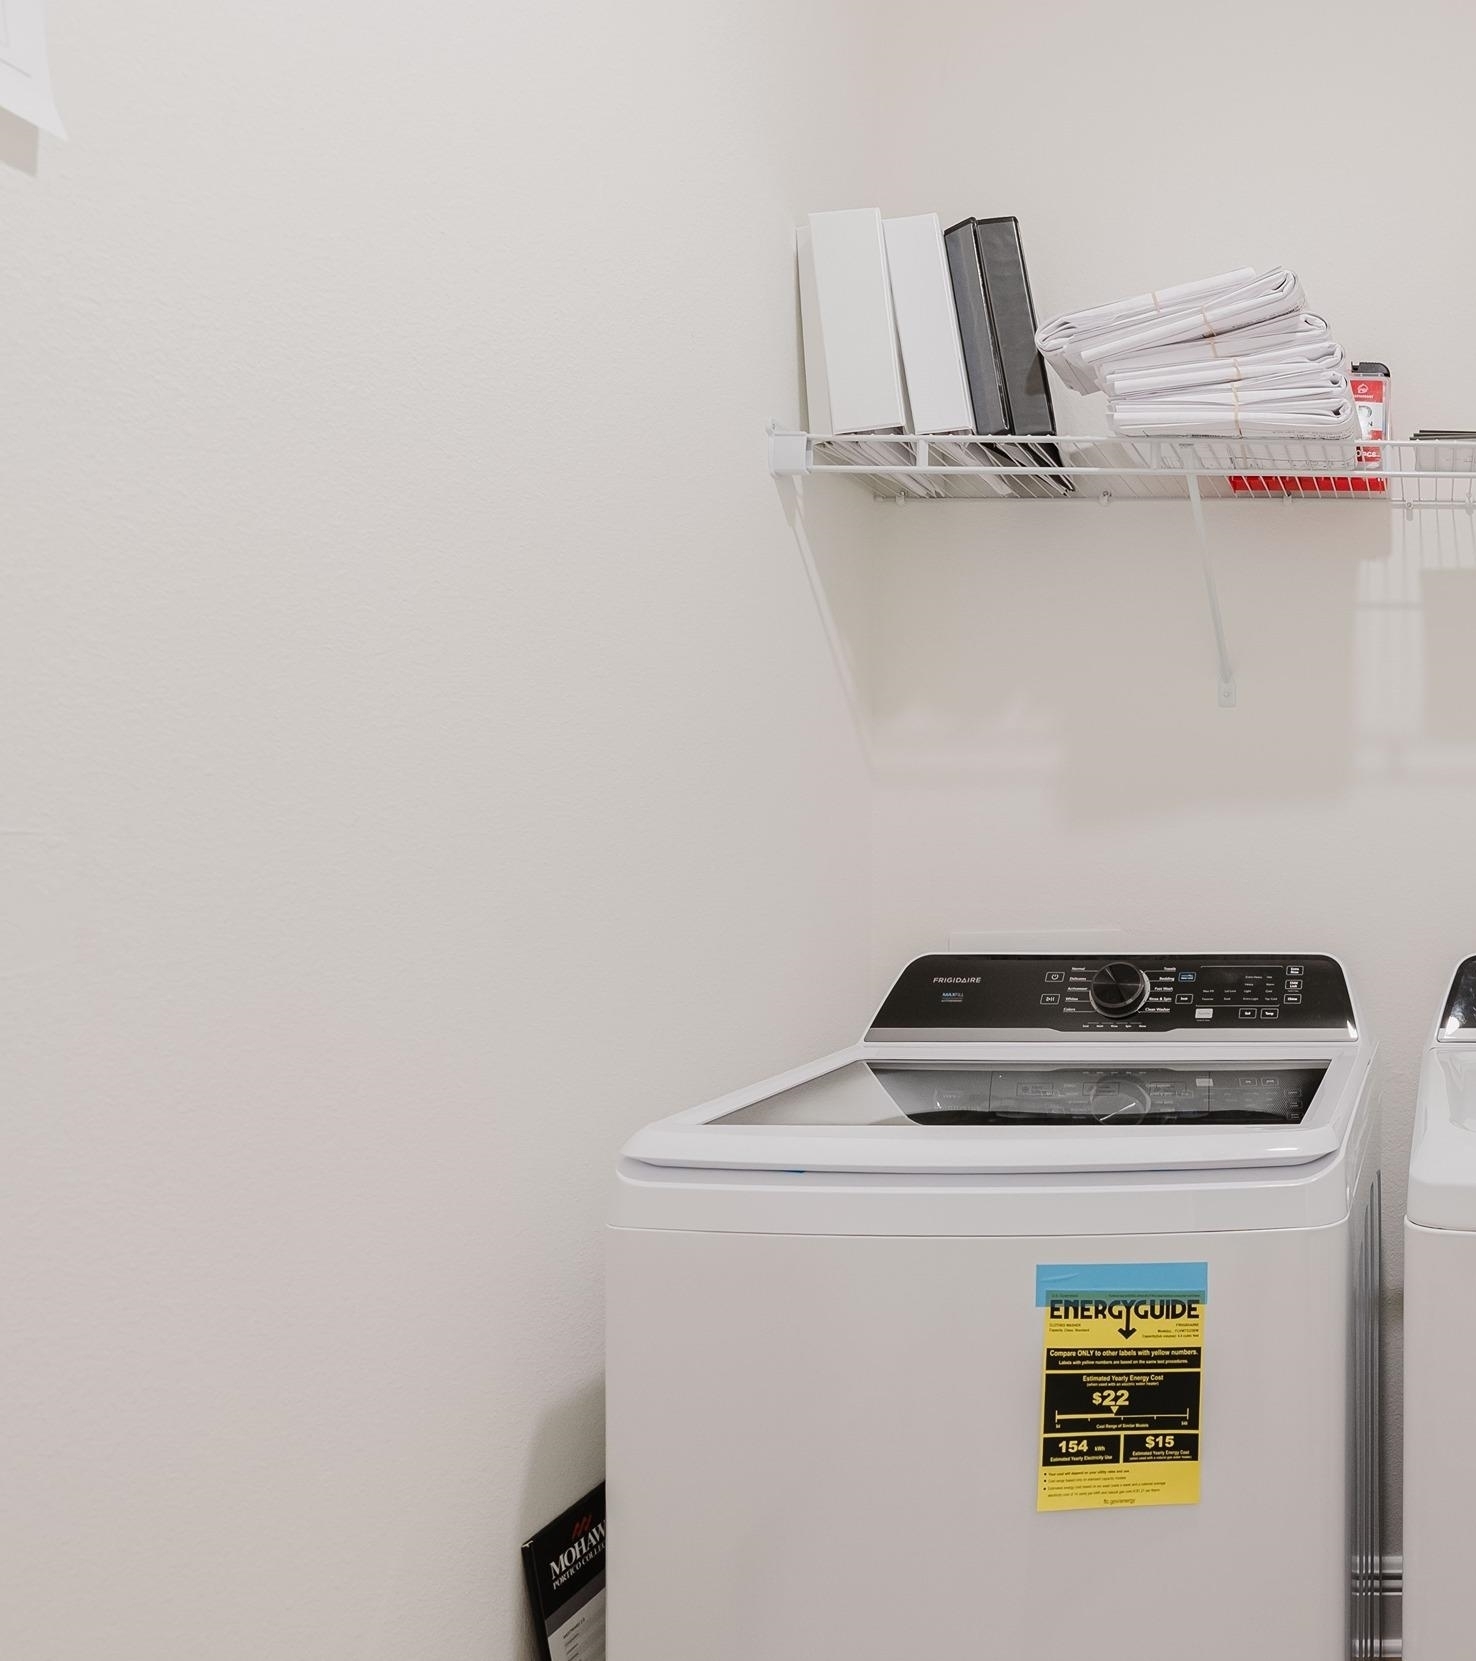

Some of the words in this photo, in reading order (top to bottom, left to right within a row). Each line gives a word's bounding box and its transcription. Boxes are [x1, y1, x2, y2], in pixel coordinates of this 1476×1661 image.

[1050, 1299, 1200, 1320] ENERGYGUIDE
[1050, 1350, 1076, 1358] Compare
[1151, 1349, 1170, 1357] yellow
[1129, 1374, 1149, 1382] Energy
[1092, 1390, 1129, 1405] $22
[1058, 1440, 1088, 1453] 154
[1145, 1435, 1175, 1449] $15
